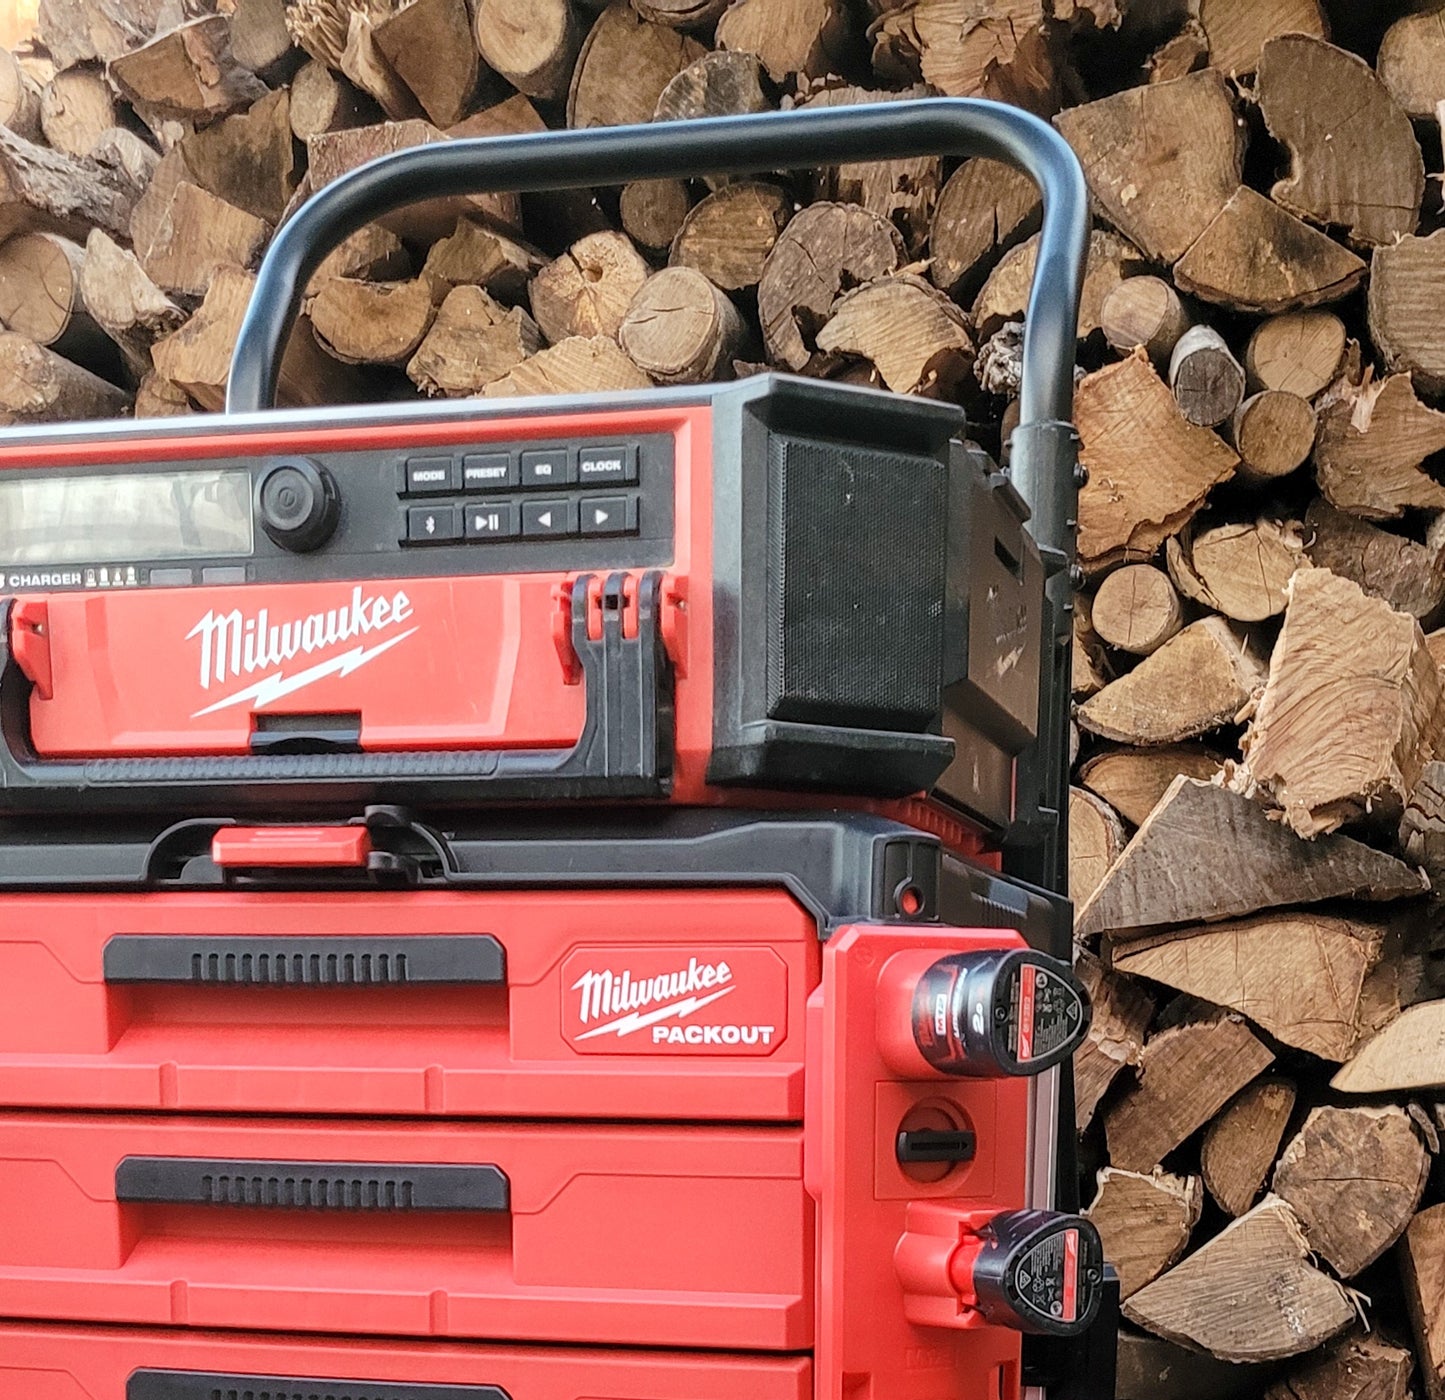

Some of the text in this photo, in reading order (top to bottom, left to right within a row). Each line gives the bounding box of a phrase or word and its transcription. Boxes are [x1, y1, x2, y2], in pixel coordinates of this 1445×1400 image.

[535, 464, 552, 475] EQ
[582, 460, 621, 472] CLOCK
[413, 469, 445, 481] MODE
[465, 467, 507, 479] PRESET
[9, 572, 82, 587] CHARGER
[184, 585, 414, 690] Milwaukee
[570, 957, 733, 1024] Milwaukee
[652, 1025, 775, 1045] PACKOUT
